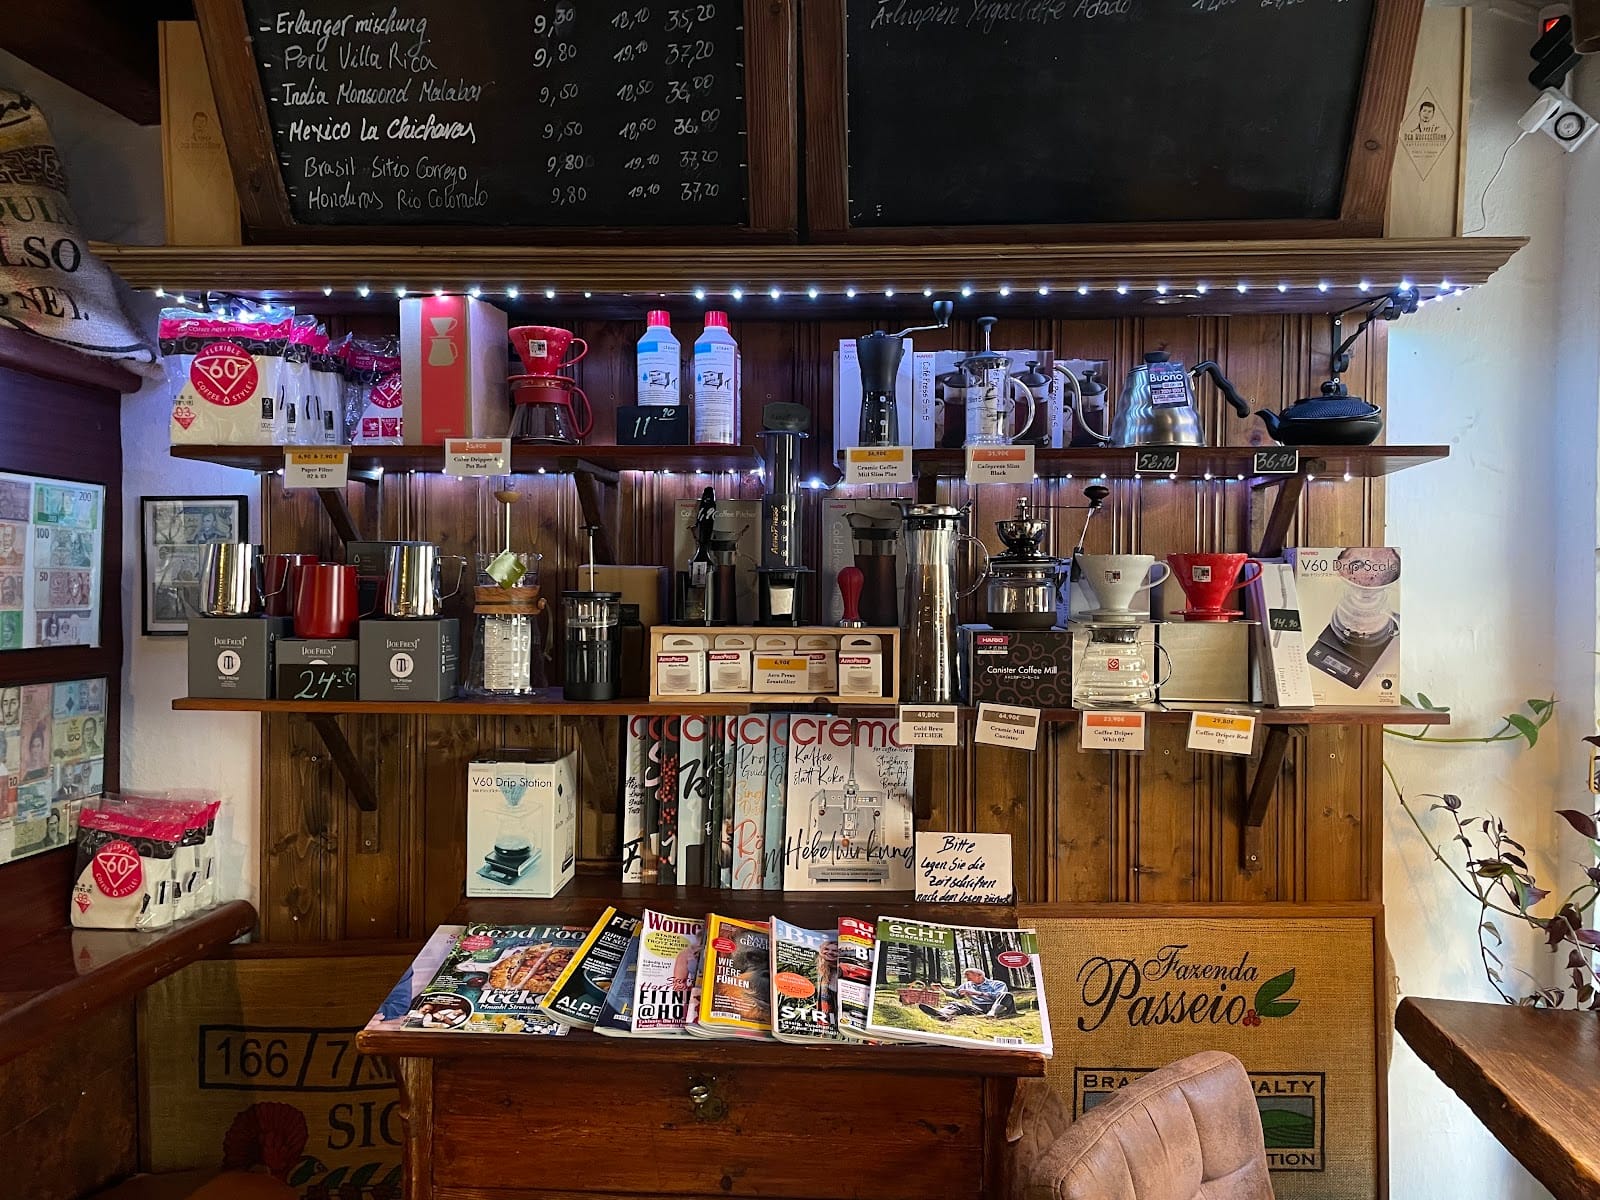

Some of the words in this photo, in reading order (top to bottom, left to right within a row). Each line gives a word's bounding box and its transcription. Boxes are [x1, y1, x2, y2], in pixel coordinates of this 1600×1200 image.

[276, 9, 354, 53] Erlanger
[339, 42, 382, 70] Villa
[389, 41, 438, 73] Rica
[282, 77, 329, 106] India
[419, 78, 489, 103] Malabar
[289, 116, 350, 143] Mexico
[360, 118, 379, 142] La
[304, 156, 355, 178] Brasil
[372, 155, 410, 179] Sitio
[308, 181, 384, 210] Honduras
[397, 188, 422, 210] Rio
[428, 179, 488, 210] Colorado
[205, 346, 241, 356] FLEXIBLE
[1150, 374, 1184, 382] Buono
[197, 380, 220, 401] COFFEE
[1301, 560, 1328, 572] V60
[1332, 560, 1359, 574] Drip
[1364, 558, 1398, 572] Scale
[986, 666, 1016, 674] Canister
[1018, 666, 1042, 674] Coffee
[1044, 666, 1058, 674] Mill
[472, 777, 492, 787] V60
[496, 777, 516, 788] Drip
[520, 778, 552, 788] Station
[784, 829, 914, 869] Hebelwirkung
[936, 836, 976, 854] Bitte
[968, 856, 986, 870] die
[468, 926, 532, 940] Good
[542, 926, 588, 940] Foo
[648, 911, 702, 936] Wome
[717, 966, 741, 976] TIERE
[718, 957, 734, 968] WIE
[1142, 945, 1259, 982] Fazenda
[1076, 957, 1247, 1032] Passeio
[558, 995, 600, 1015] ALPE
[638, 1004, 688, 1020] @HO
[217, 1037, 288, 1078] 166
[1083, 1074, 1131, 1089] BRA
[1270, 1152, 1316, 1166] TION
